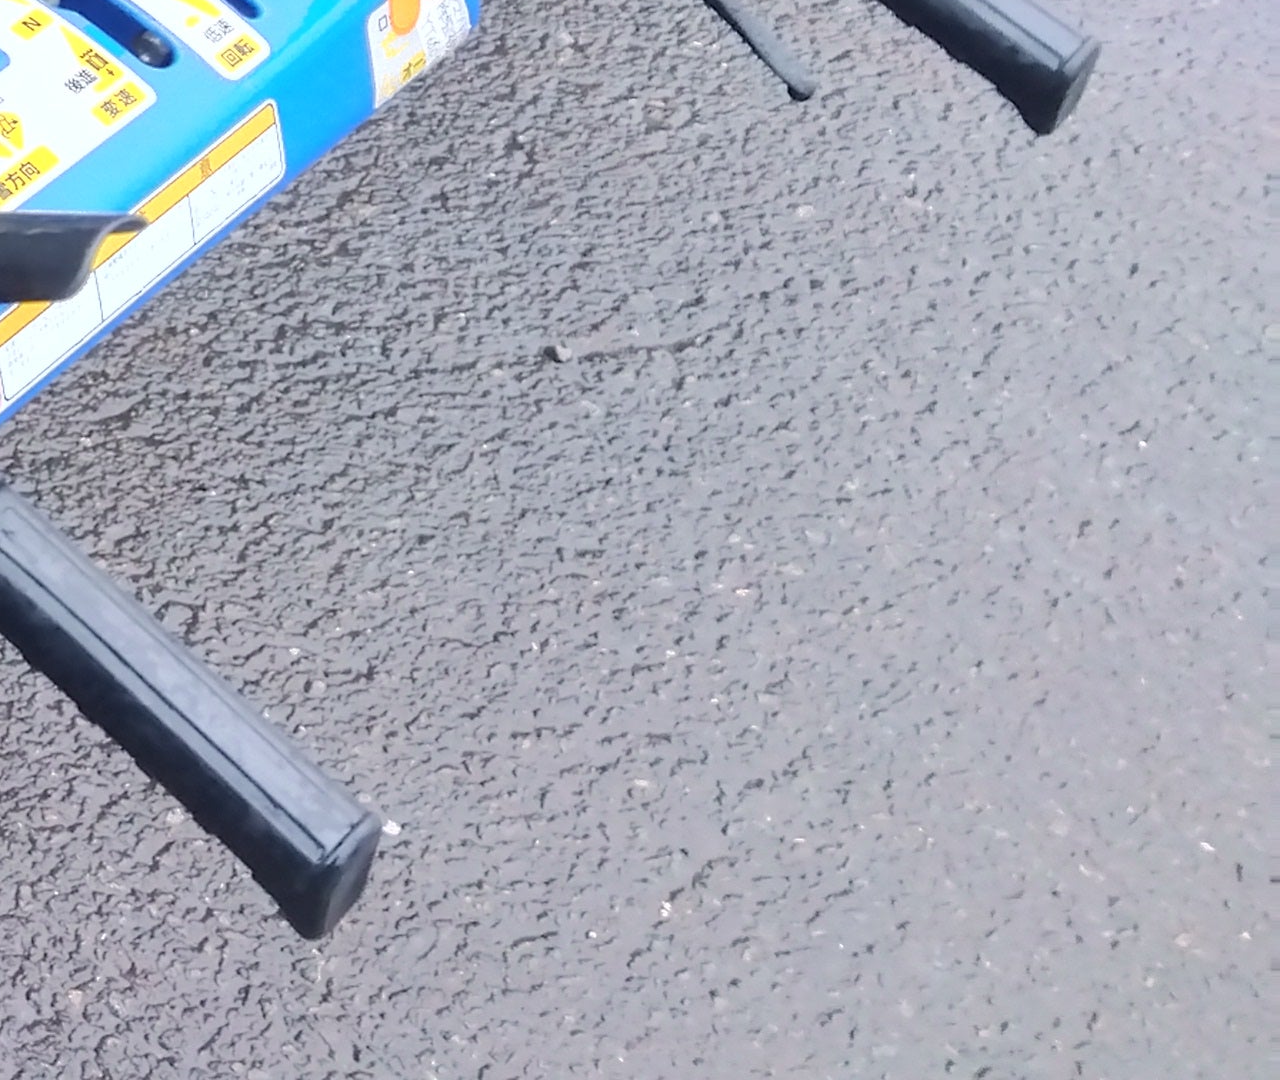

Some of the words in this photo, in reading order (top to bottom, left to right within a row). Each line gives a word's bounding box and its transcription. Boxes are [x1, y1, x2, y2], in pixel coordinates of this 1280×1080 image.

[21, 16, 42, 32] N
[221, 38, 255, 67] 回転
[99, 88, 138, 119] 変速
